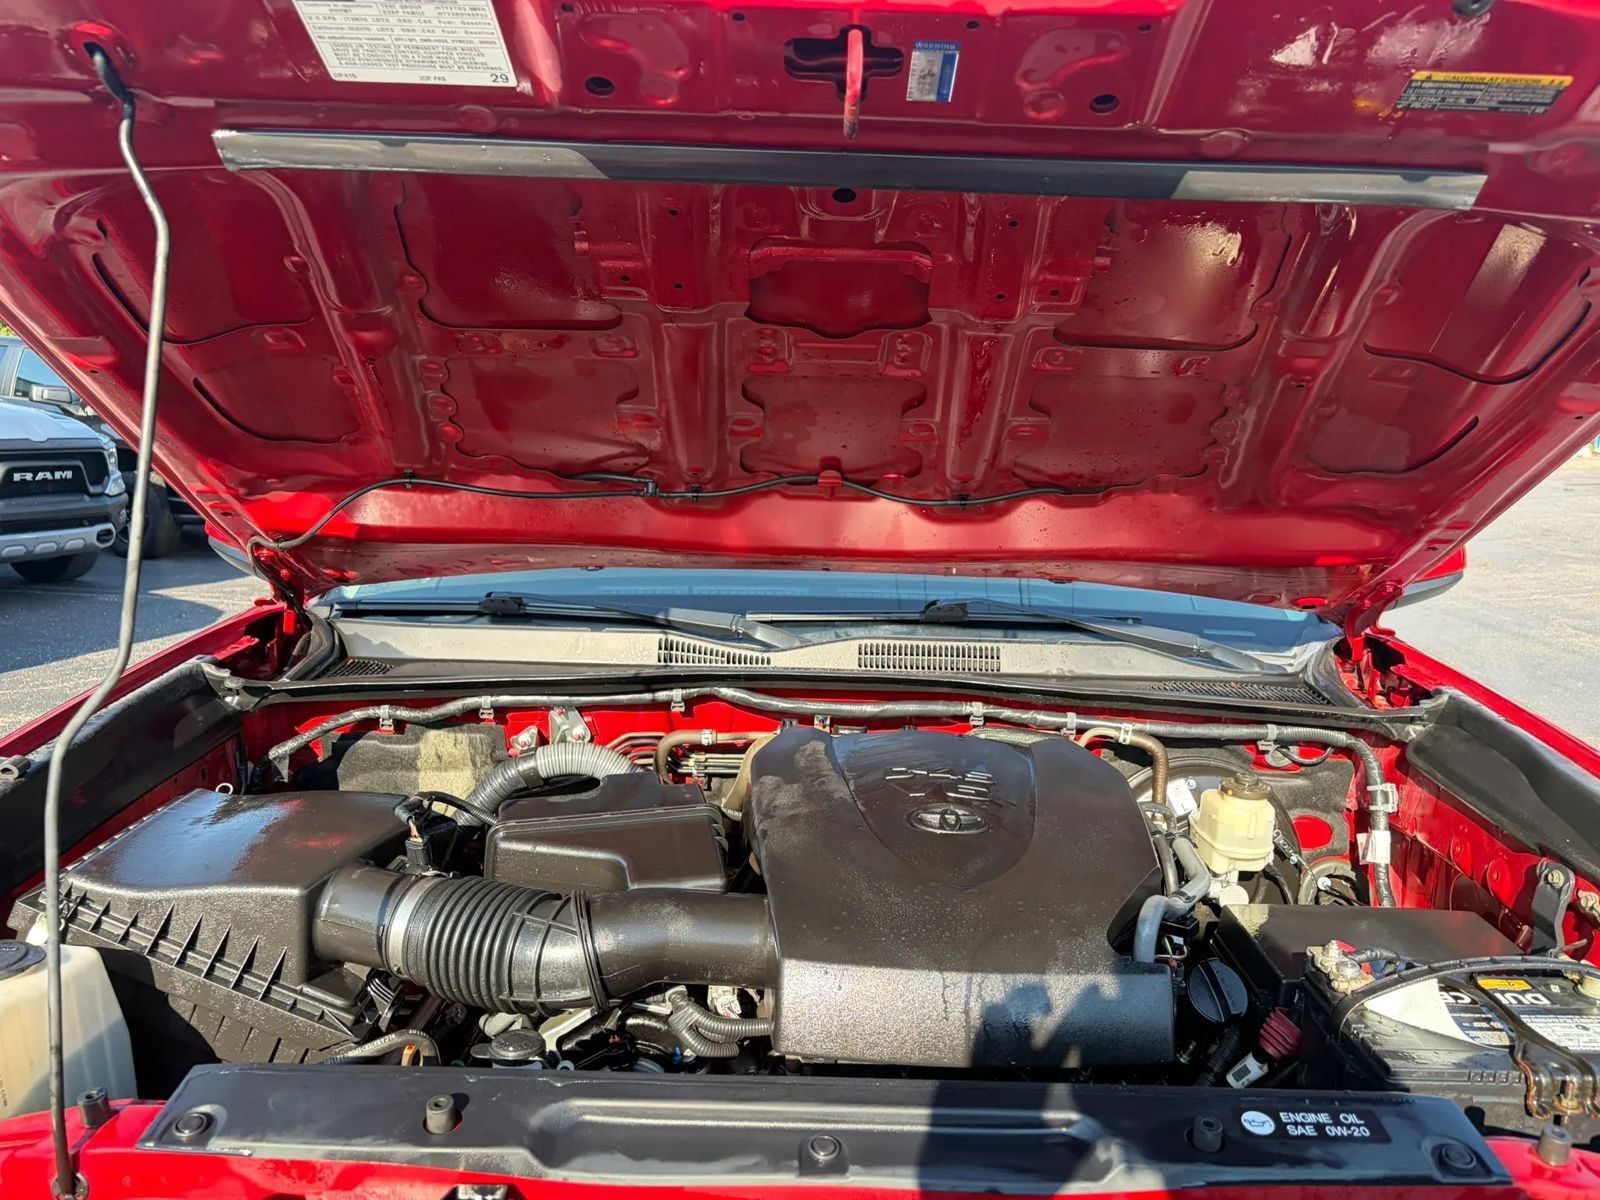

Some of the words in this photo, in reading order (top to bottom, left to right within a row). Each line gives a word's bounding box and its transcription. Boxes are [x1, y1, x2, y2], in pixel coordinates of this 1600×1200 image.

[490, 73, 509, 83] 29
[13, 470, 73, 482] RAM
[1279, 1112, 1333, 1124] ENGINE
[1339, 1113, 1365, 1125] OIL
[1286, 1124, 1318, 1137] SAE
[1325, 1125, 1370, 1138] 0W-20
